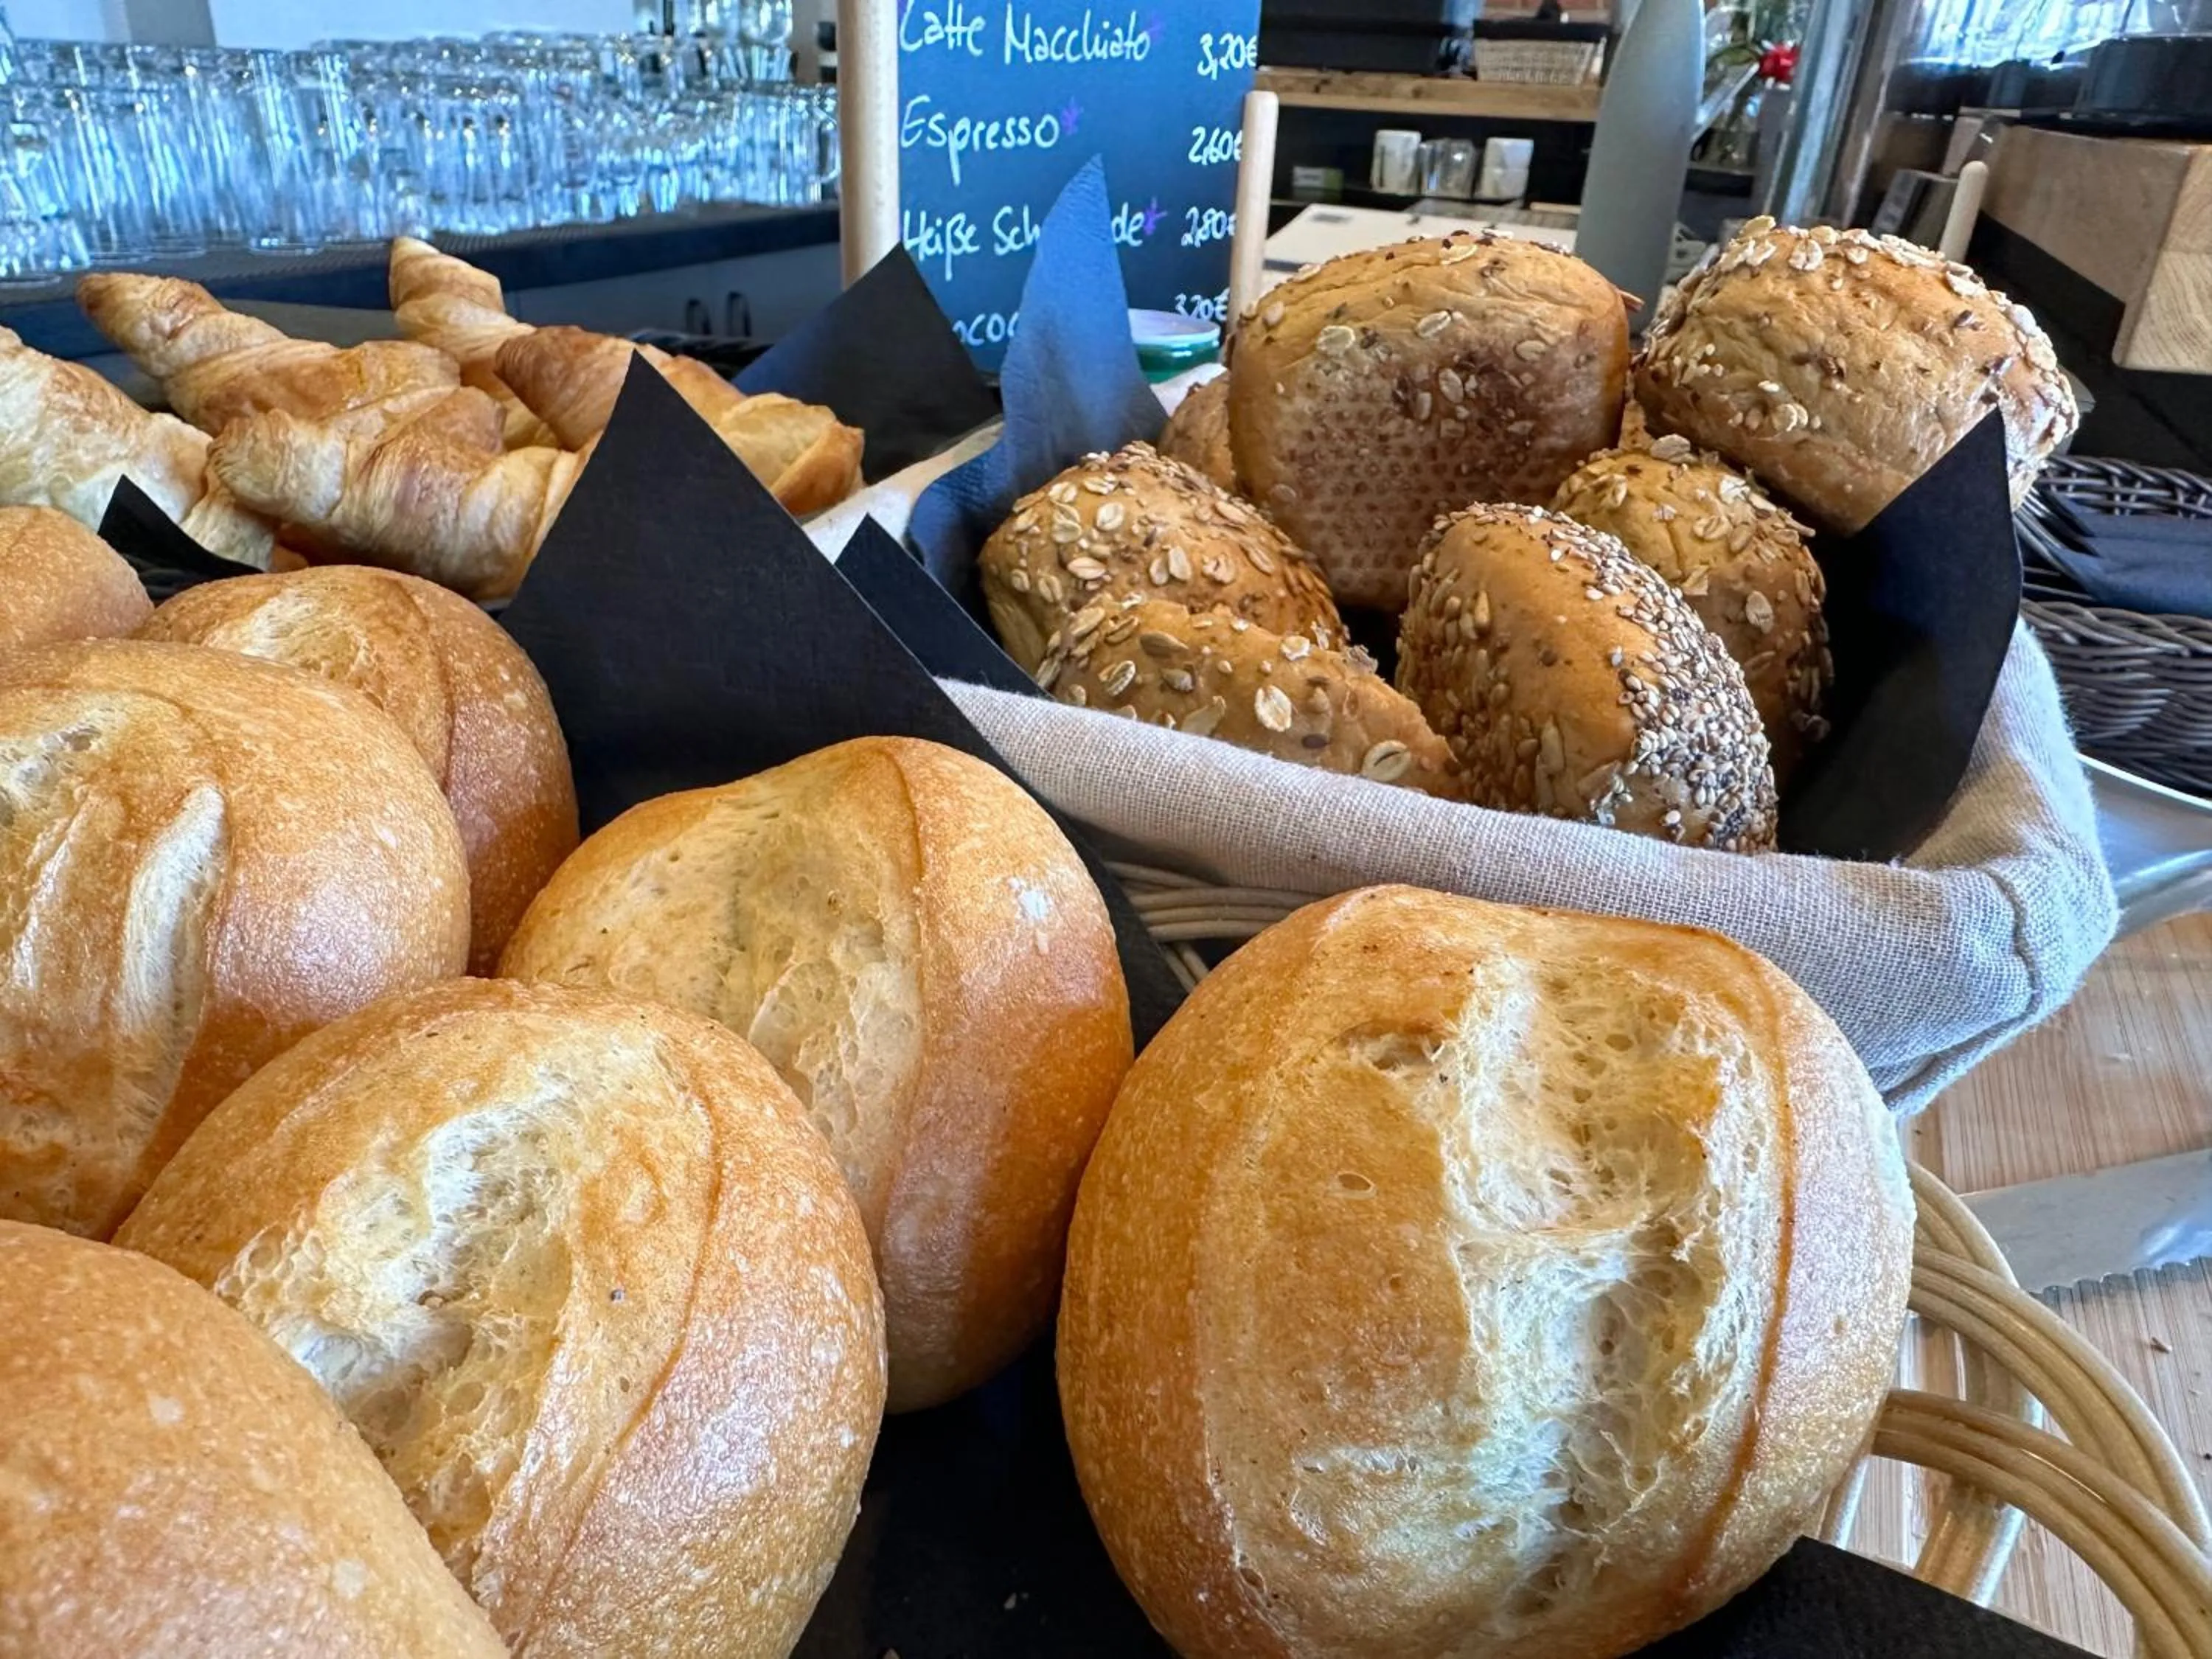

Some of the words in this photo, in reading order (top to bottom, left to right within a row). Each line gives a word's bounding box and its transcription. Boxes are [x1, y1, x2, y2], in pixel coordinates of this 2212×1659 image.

[900, 0, 985, 56] Latte
[1004, 1, 1150, 65] Macchiato
[900, 94, 1060, 186] Espresso
